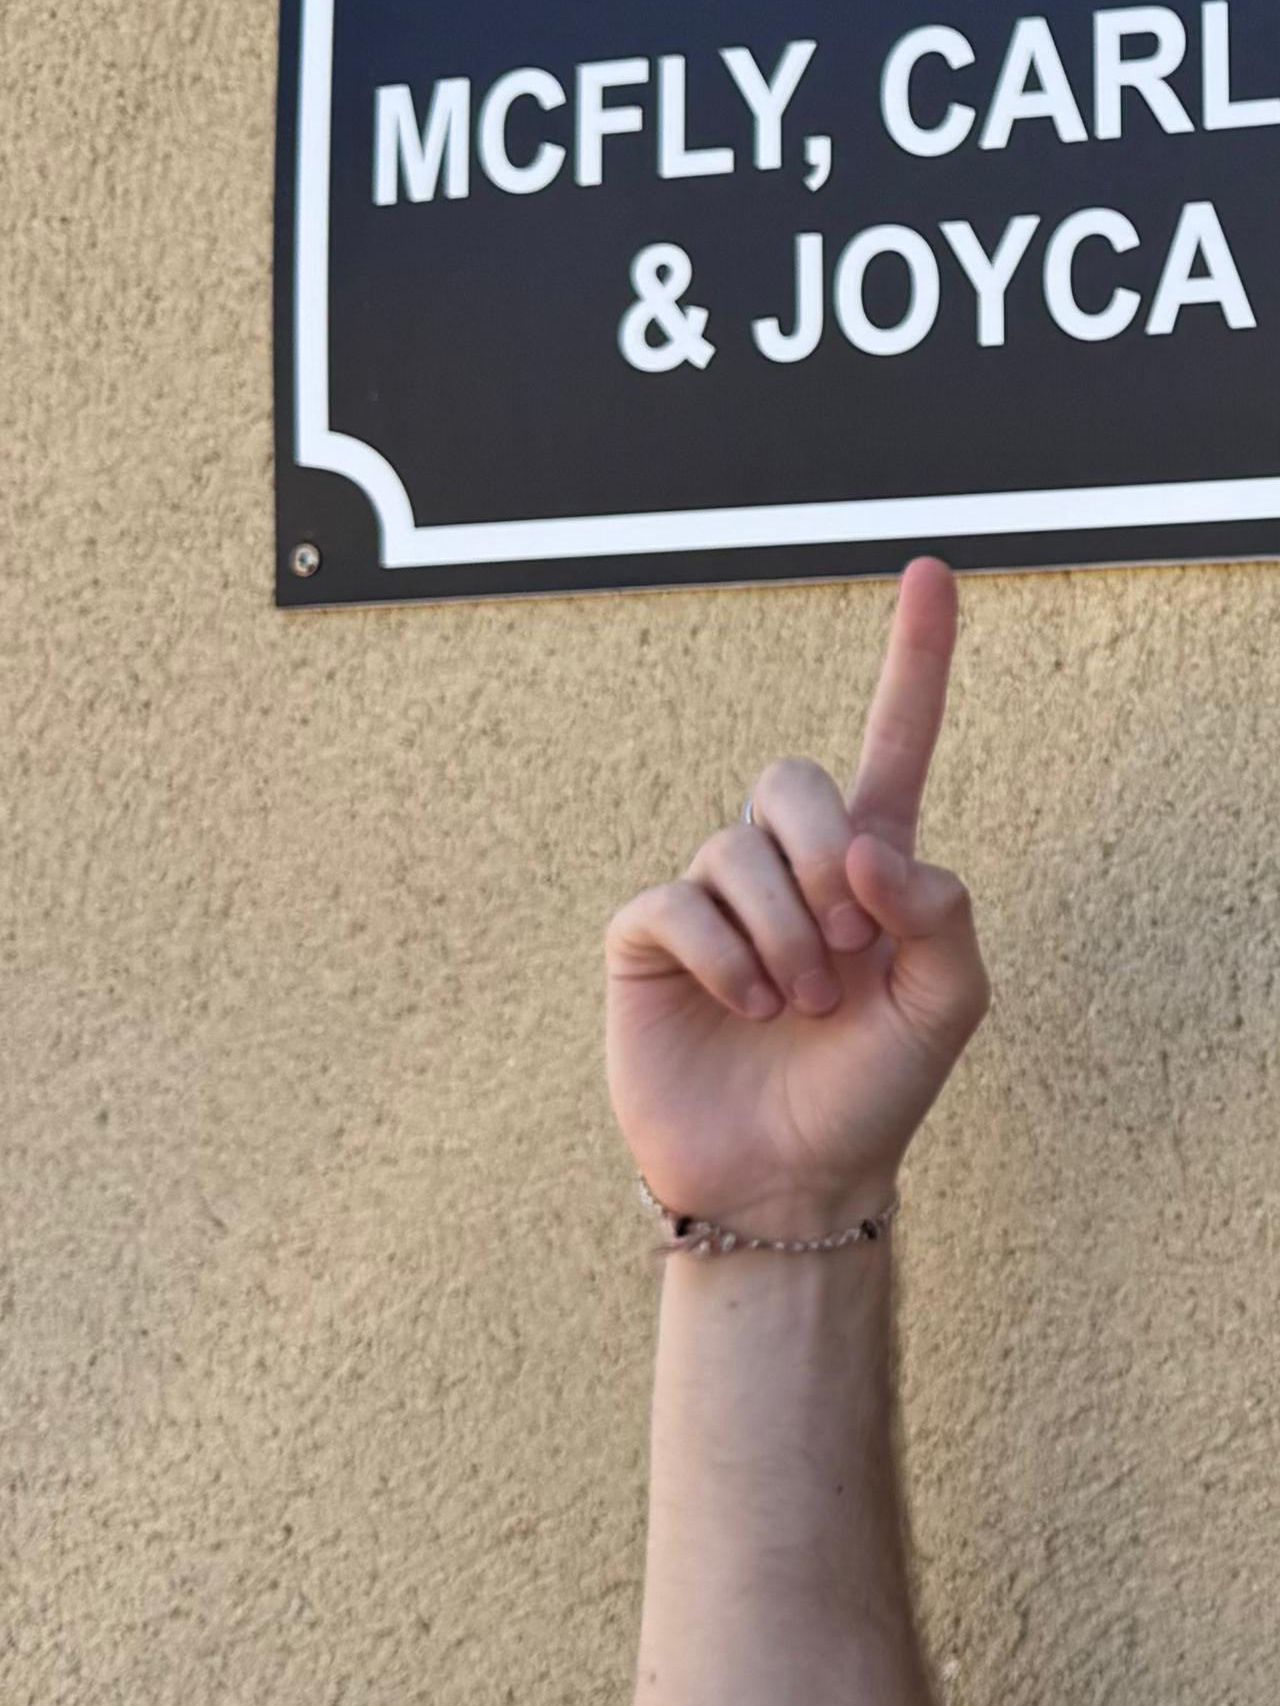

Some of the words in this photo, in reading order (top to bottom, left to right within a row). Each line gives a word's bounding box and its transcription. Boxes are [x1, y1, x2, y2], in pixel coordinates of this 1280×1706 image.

[374, 40, 833, 207] MCFLY,
[619, 243, 716, 373] &
[753, 201, 1257, 364] JOYCA
